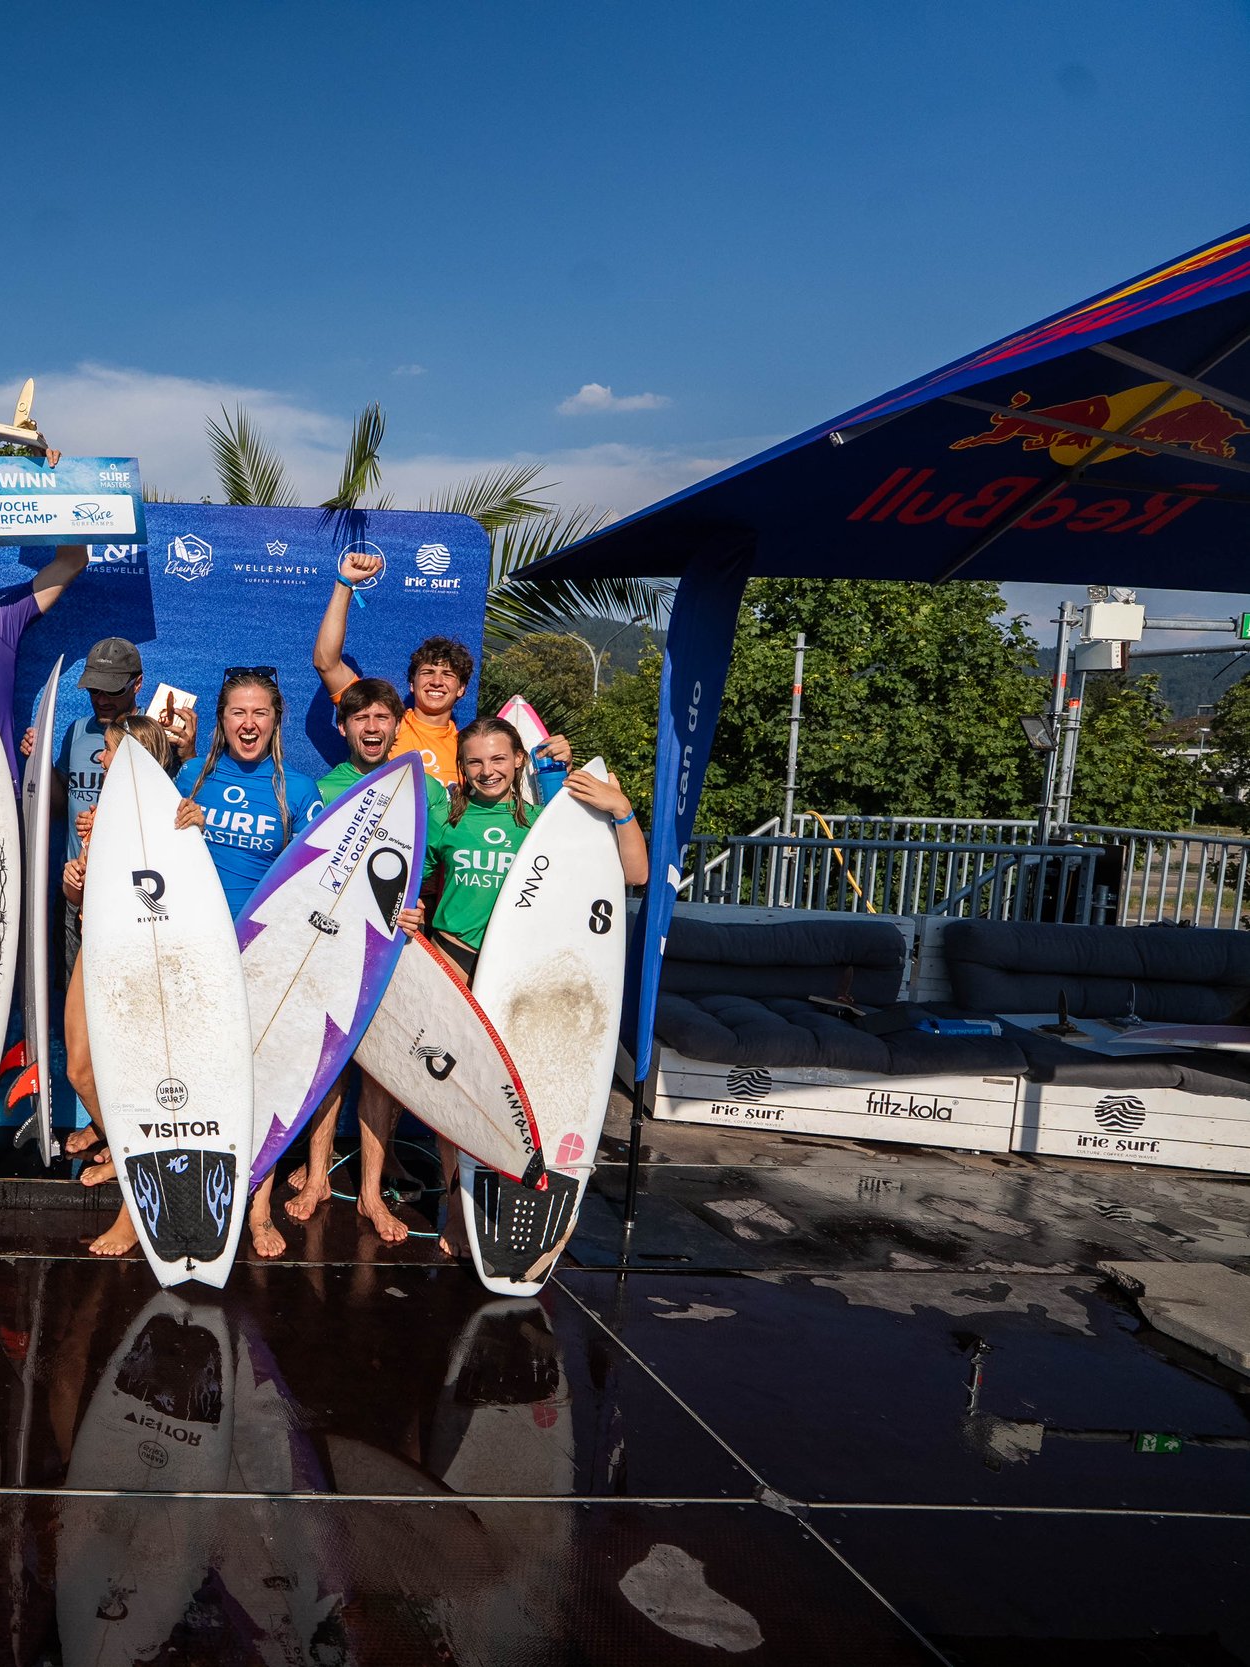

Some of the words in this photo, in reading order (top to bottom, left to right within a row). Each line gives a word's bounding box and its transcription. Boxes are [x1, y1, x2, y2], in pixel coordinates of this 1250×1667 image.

[99, 472, 130, 482] SURF
[100, 481, 132, 489] MASTERS
[75, 502, 114, 523] Pure
[86, 566, 146, 575] HASEWELLE
[164, 560, 214, 578] RheinRiff
[234, 563, 319, 575] WELLENWERK
[405, 576, 427, 587] irie
[430, 578, 461, 589] surf.
[677, 745, 693, 816] can
[687, 680, 702, 732] do
[69, 771, 101, 789] SU
[223, 786, 249, 809] O2
[376, 793, 386, 807] SEIT
[200, 805, 278, 836] URF
[331, 788, 378, 866] NIENDIEKER
[200, 827, 275, 852] ASTERS
[343, 864, 354, 873] &
[350, 811, 383, 862] OGRZAL
[483, 827, 512, 848] O2
[452, 849, 518, 874] SUR
[455, 873, 505, 889] MAST
[389, 891, 405, 928] SOORUZ
[137, 915, 170, 923] RIVVER
[159, 1086, 184, 1095] URBAN
[160, 1094, 185, 1104] SURF
[711, 1103, 740, 1117] irie
[744, 1108, 785, 1121] surf.
[866, 1091, 954, 1121] fritz-kola
[138, 1120, 220, 1139] VISITOR
[1077, 1135, 1110, 1148] irie
[1115, 1139, 1160, 1153] surf.
